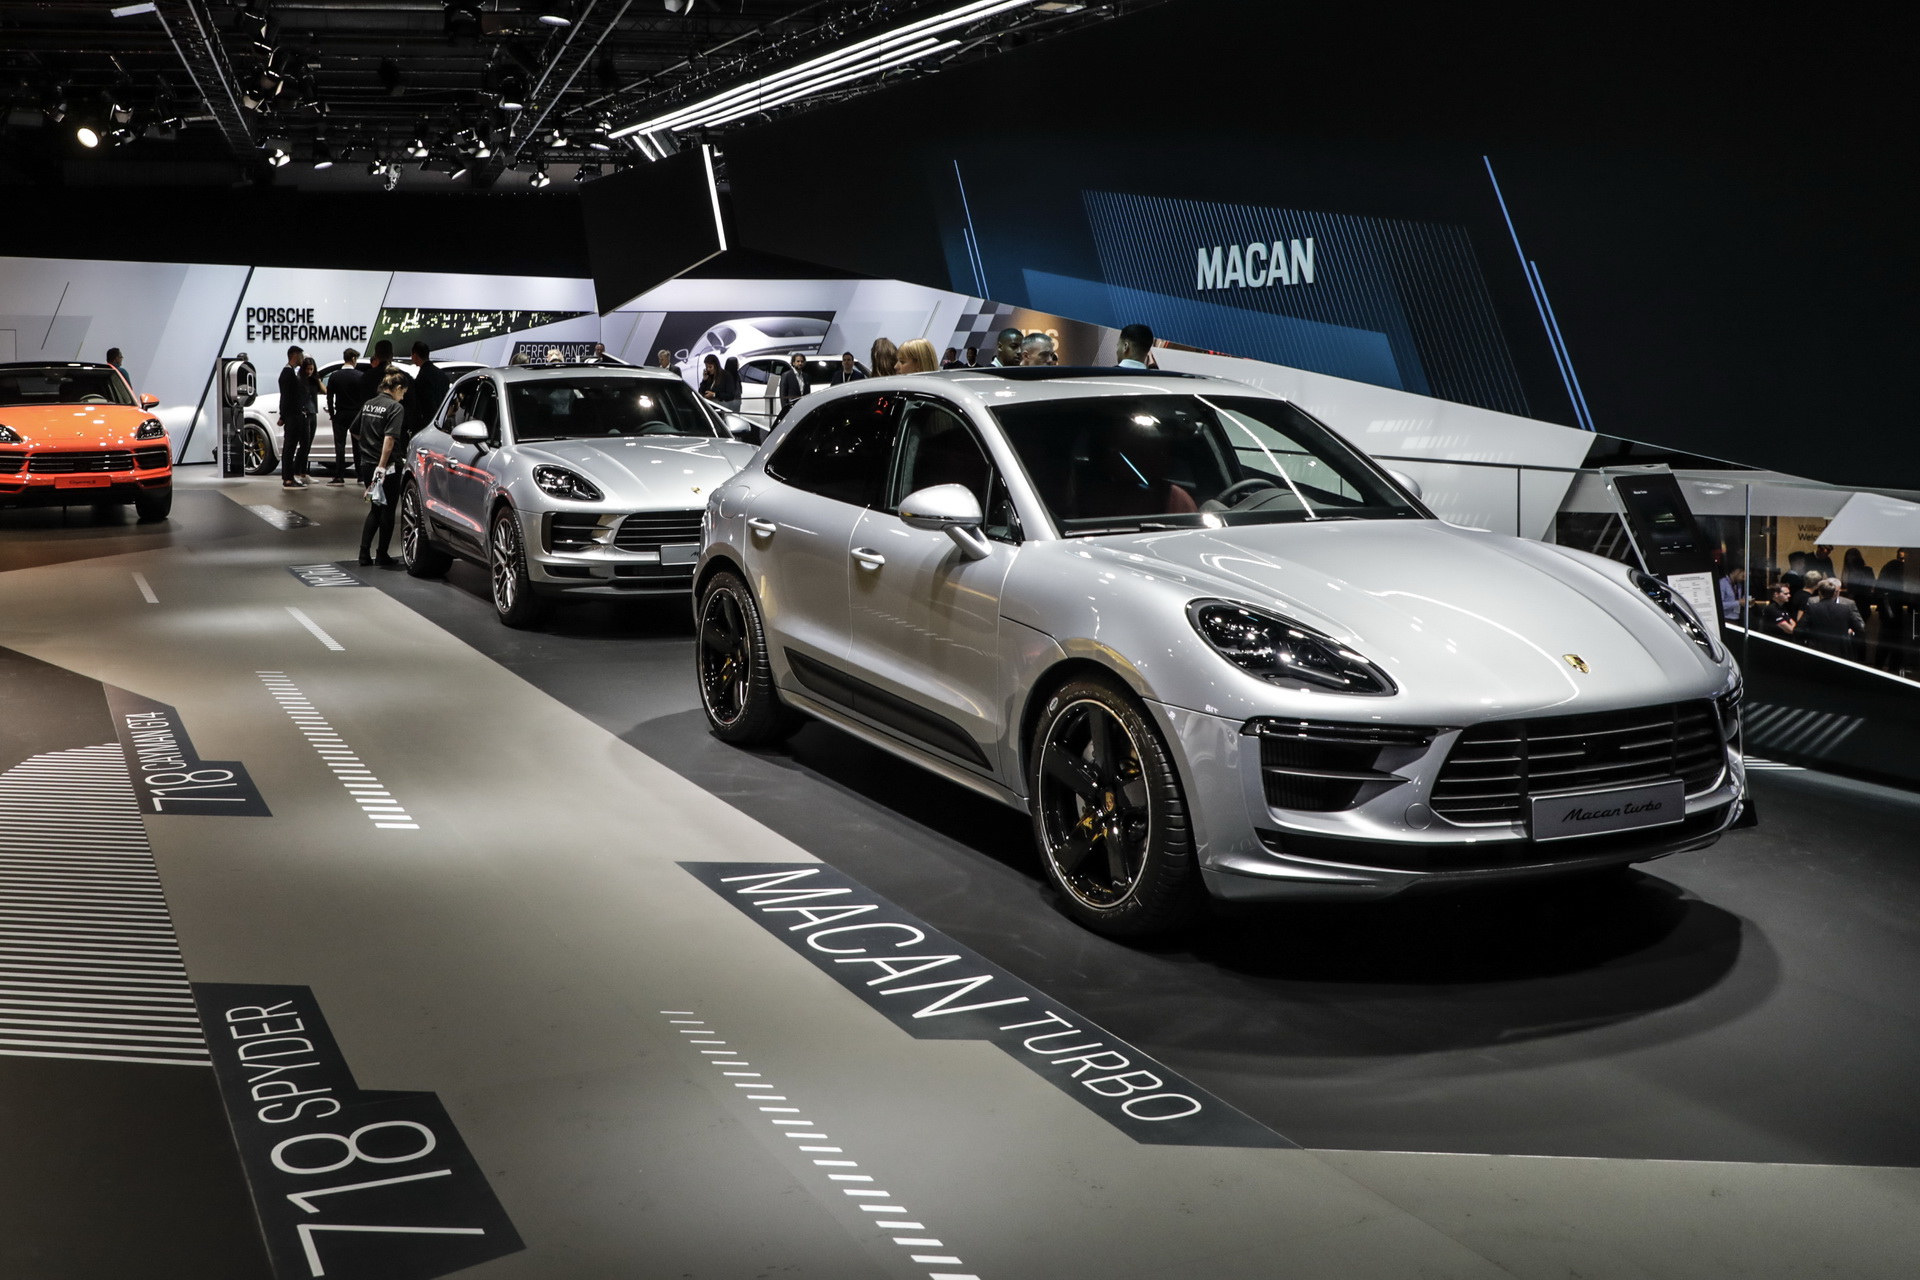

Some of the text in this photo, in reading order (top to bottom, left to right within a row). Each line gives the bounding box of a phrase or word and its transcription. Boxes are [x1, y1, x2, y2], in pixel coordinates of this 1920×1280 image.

[1197, 238, 1314, 290] MACAN
[246, 307, 315, 324] PORSCHE
[246, 325, 368, 341] E-PERFORMANCE
[288, 564, 360, 587] MACAN
[125, 711, 246, 812] 718 CAYMAN GT4
[1562, 800, 1663, 823] Macan turbo
[720, 867, 1203, 1122] MACAN TURBO
[225, 999, 486, 1278] 718 SPYDER
